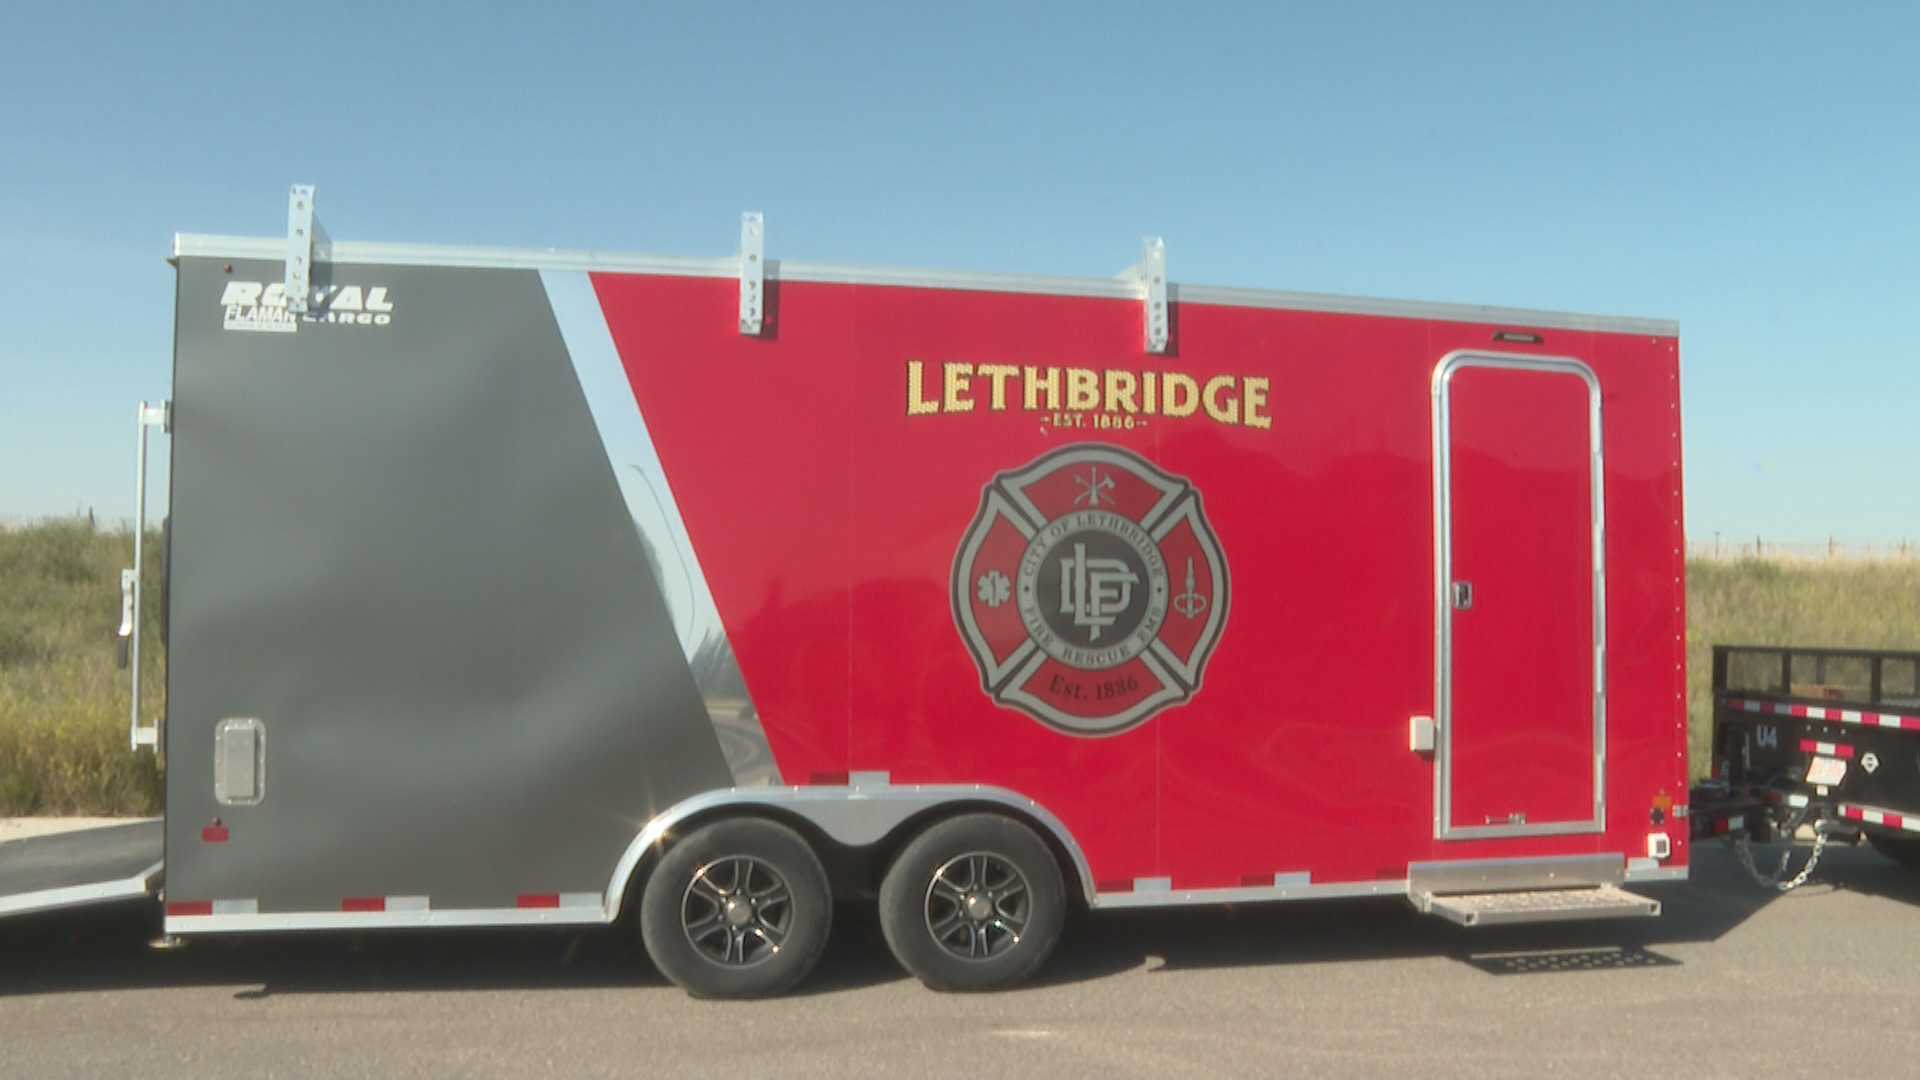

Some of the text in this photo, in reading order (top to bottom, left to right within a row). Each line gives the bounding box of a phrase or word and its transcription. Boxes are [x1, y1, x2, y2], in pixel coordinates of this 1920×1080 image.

[302, 311, 391, 325] CARGO
[906, 360, 1273, 430] LETHBRIDGE
[1024, 513, 1163, 578] CITY OF LETHBRIDGE
[1024, 606, 1162, 665] FIRE RESCUE EMS
[1049, 673, 1139, 701] Est. 1886
[1756, 725, 1778, 748] U4
